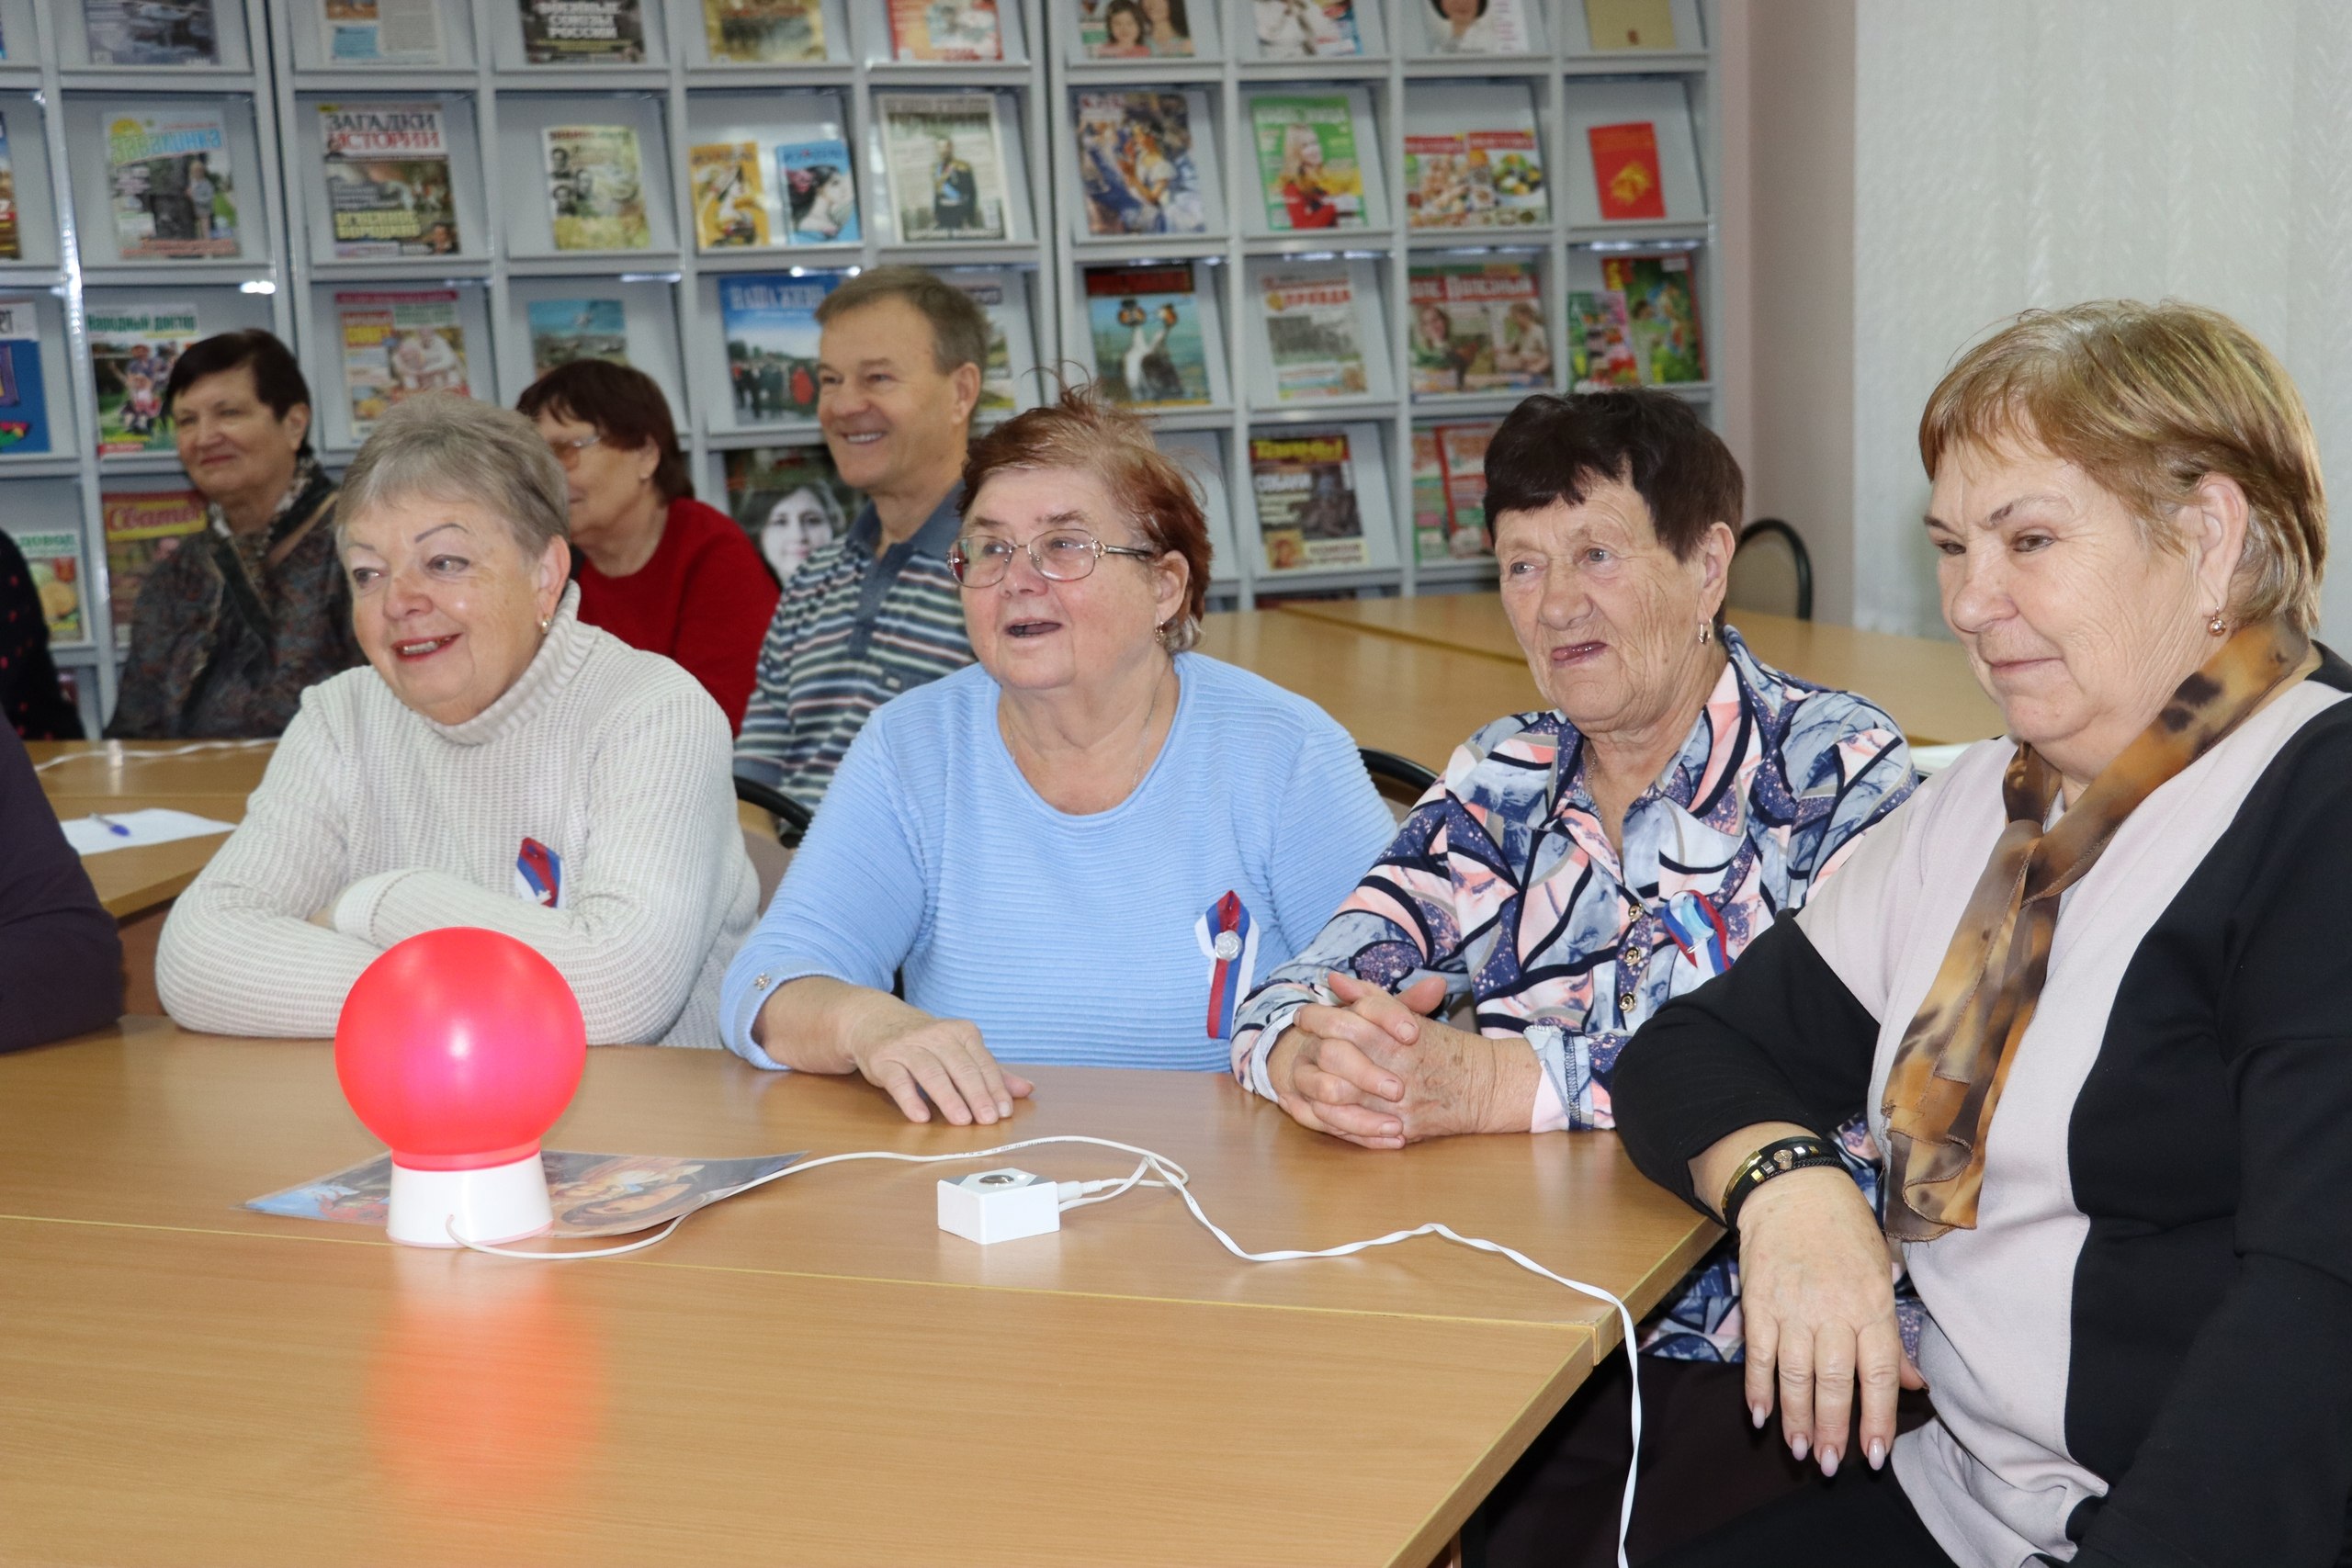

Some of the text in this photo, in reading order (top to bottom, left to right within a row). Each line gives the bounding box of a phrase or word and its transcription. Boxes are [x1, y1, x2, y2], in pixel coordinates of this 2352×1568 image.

[547, 28, 618, 39] РОССИИ
[326, 113, 436, 131] ЗАГАДКИ
[329, 131, 441, 150] ИСТОРИИ
[87, 314, 149, 333] Народный
